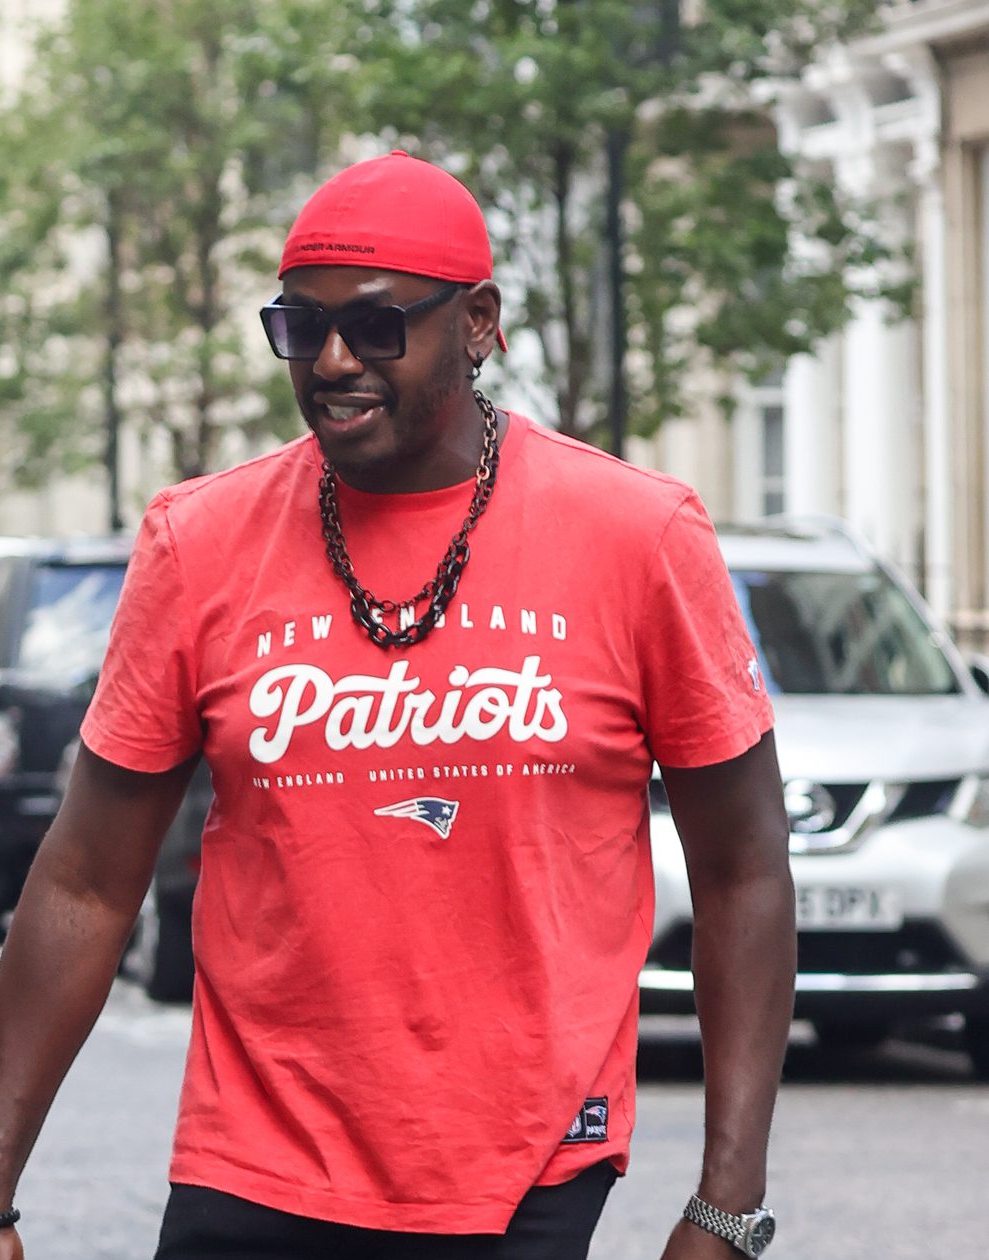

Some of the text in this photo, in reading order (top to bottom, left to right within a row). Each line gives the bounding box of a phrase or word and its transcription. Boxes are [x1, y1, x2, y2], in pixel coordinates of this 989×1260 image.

[297, 243, 325, 252] NDER
[256, 614, 333, 658] NEW
[248, 654, 569, 764] Patriots
[277, 771, 345, 788] ENGLAND
[368, 763, 576, 782] UNITED STATES OF AMERICA
